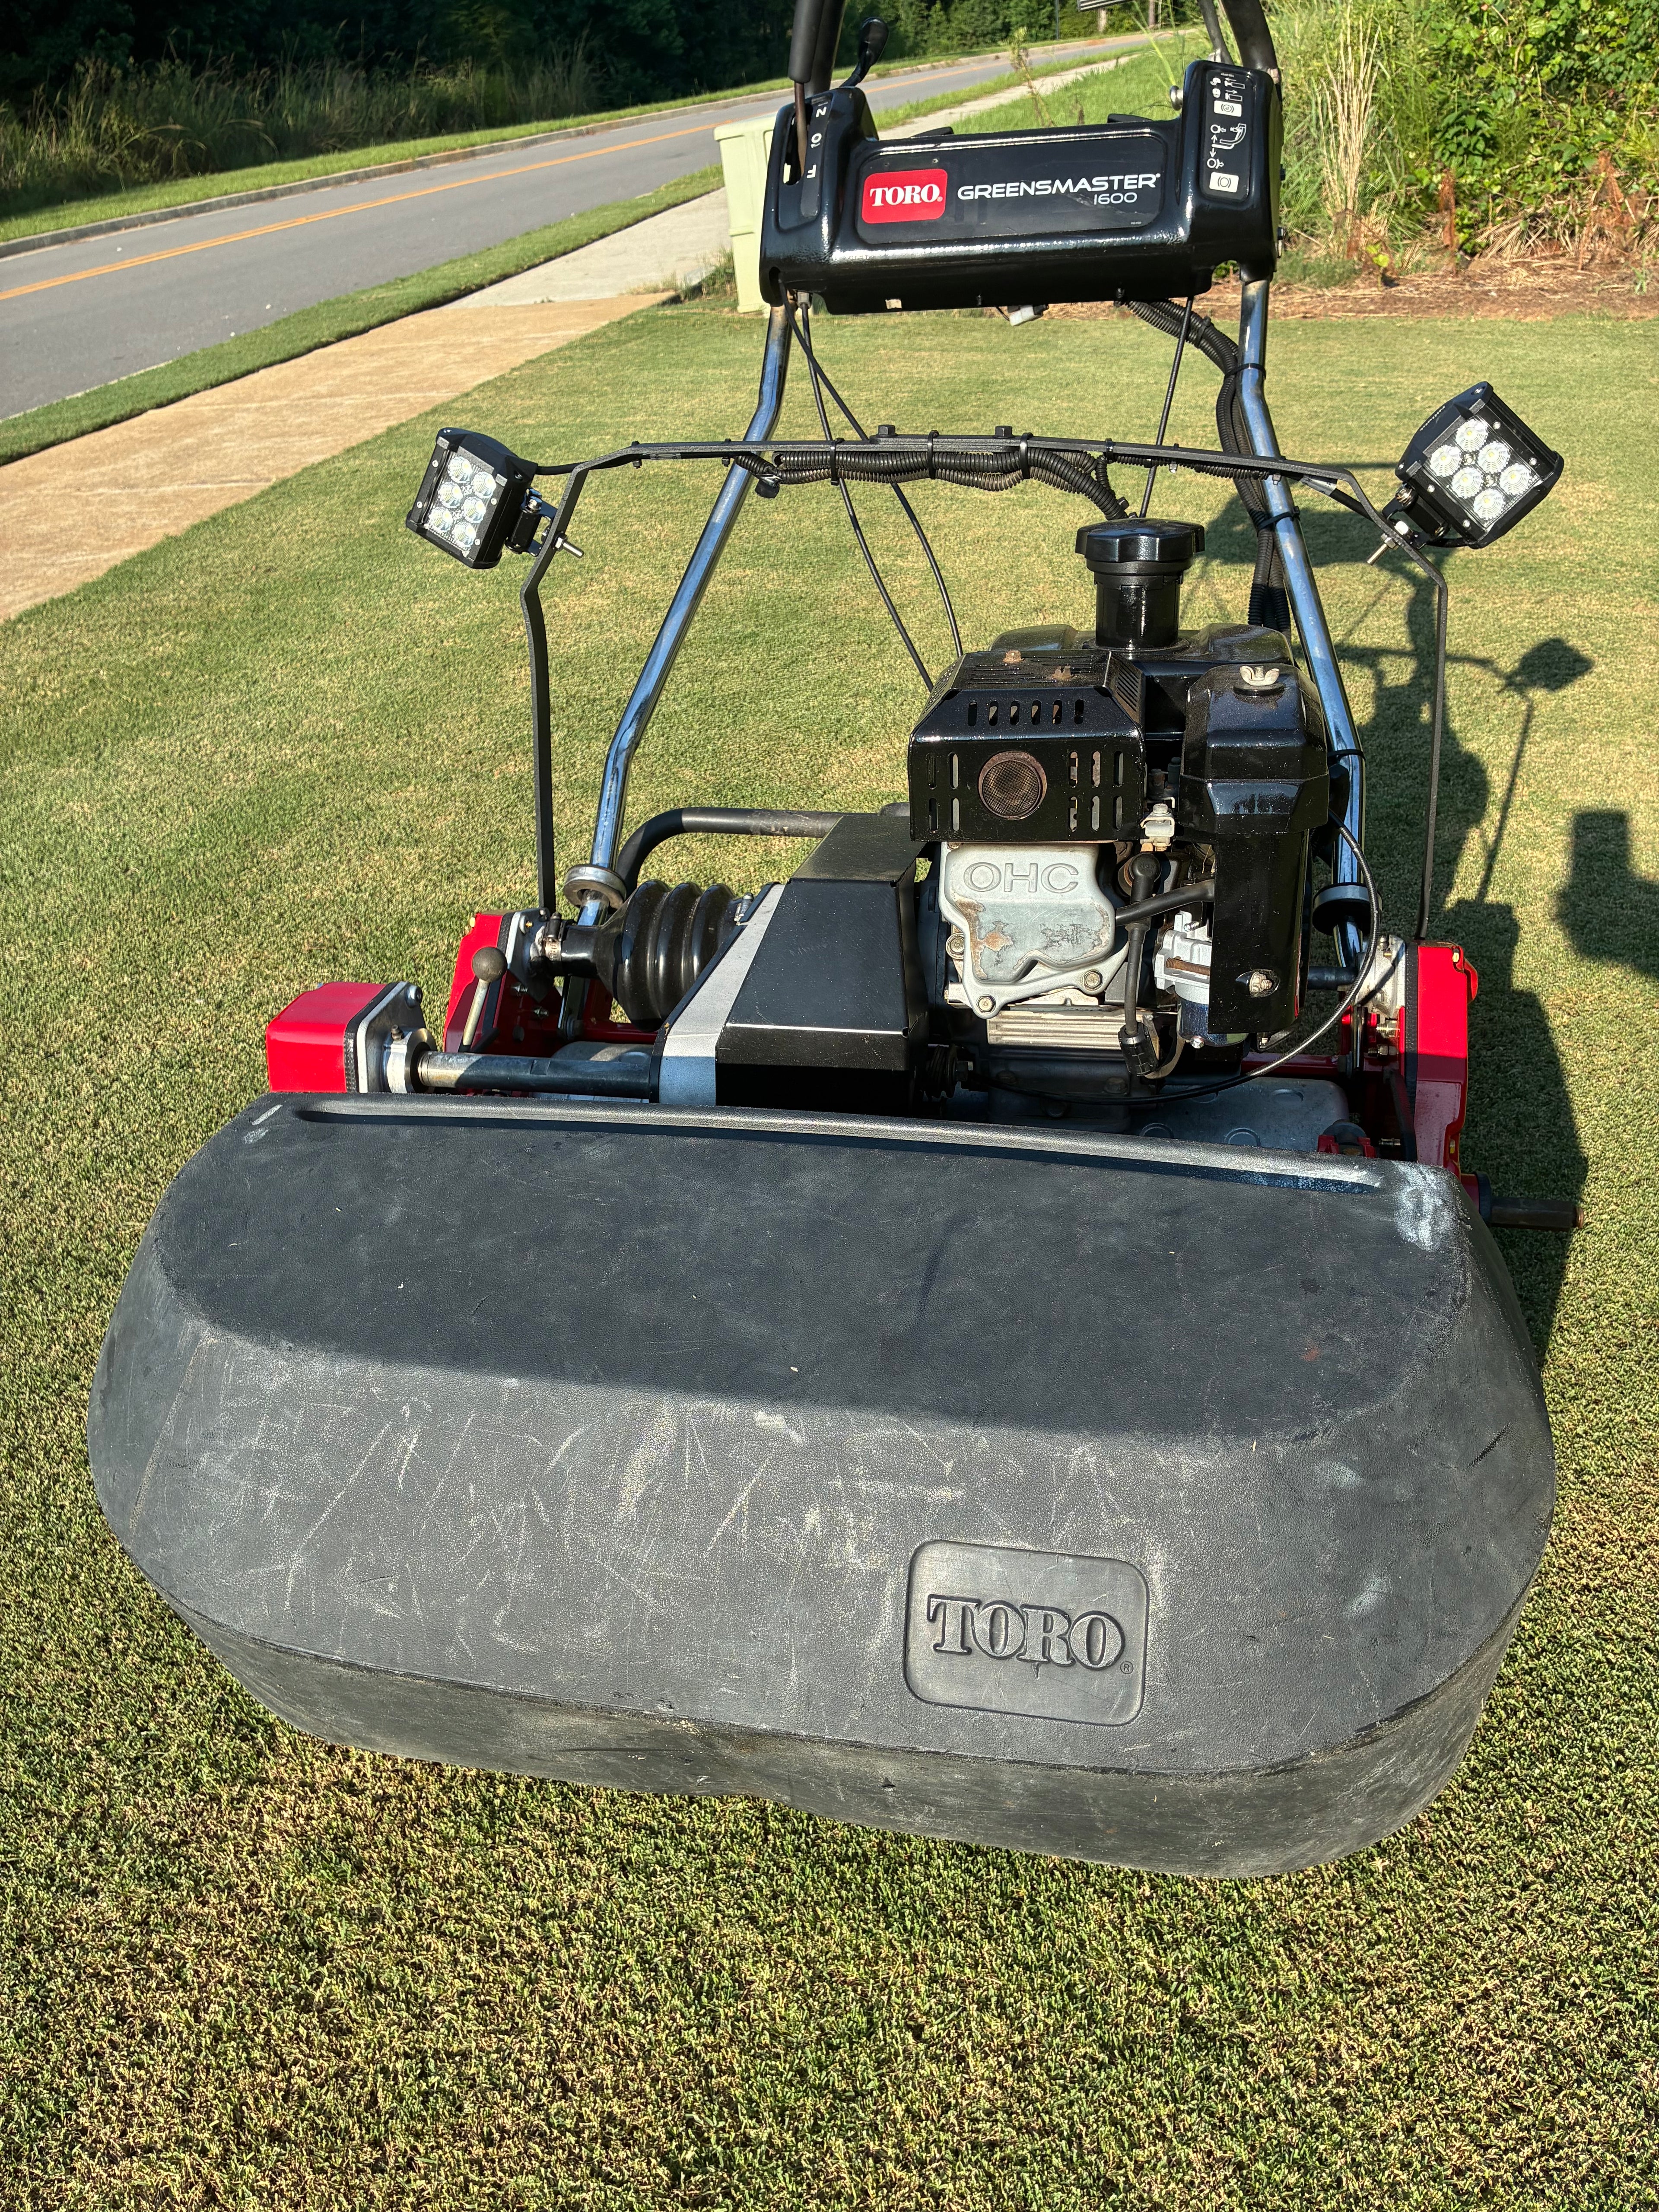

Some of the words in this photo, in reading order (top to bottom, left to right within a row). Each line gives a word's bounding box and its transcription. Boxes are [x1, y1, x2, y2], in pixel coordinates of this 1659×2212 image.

[816, 107, 827, 118] N
[807, 164, 817, 178] F
[870, 184, 940, 206] TORO
[957, 174, 1157, 200] GREENSMASTER
[1094, 192, 1138, 205] 1600
[963, 862, 1079, 893] OHC
[927, 1594, 1125, 1671] TORO
